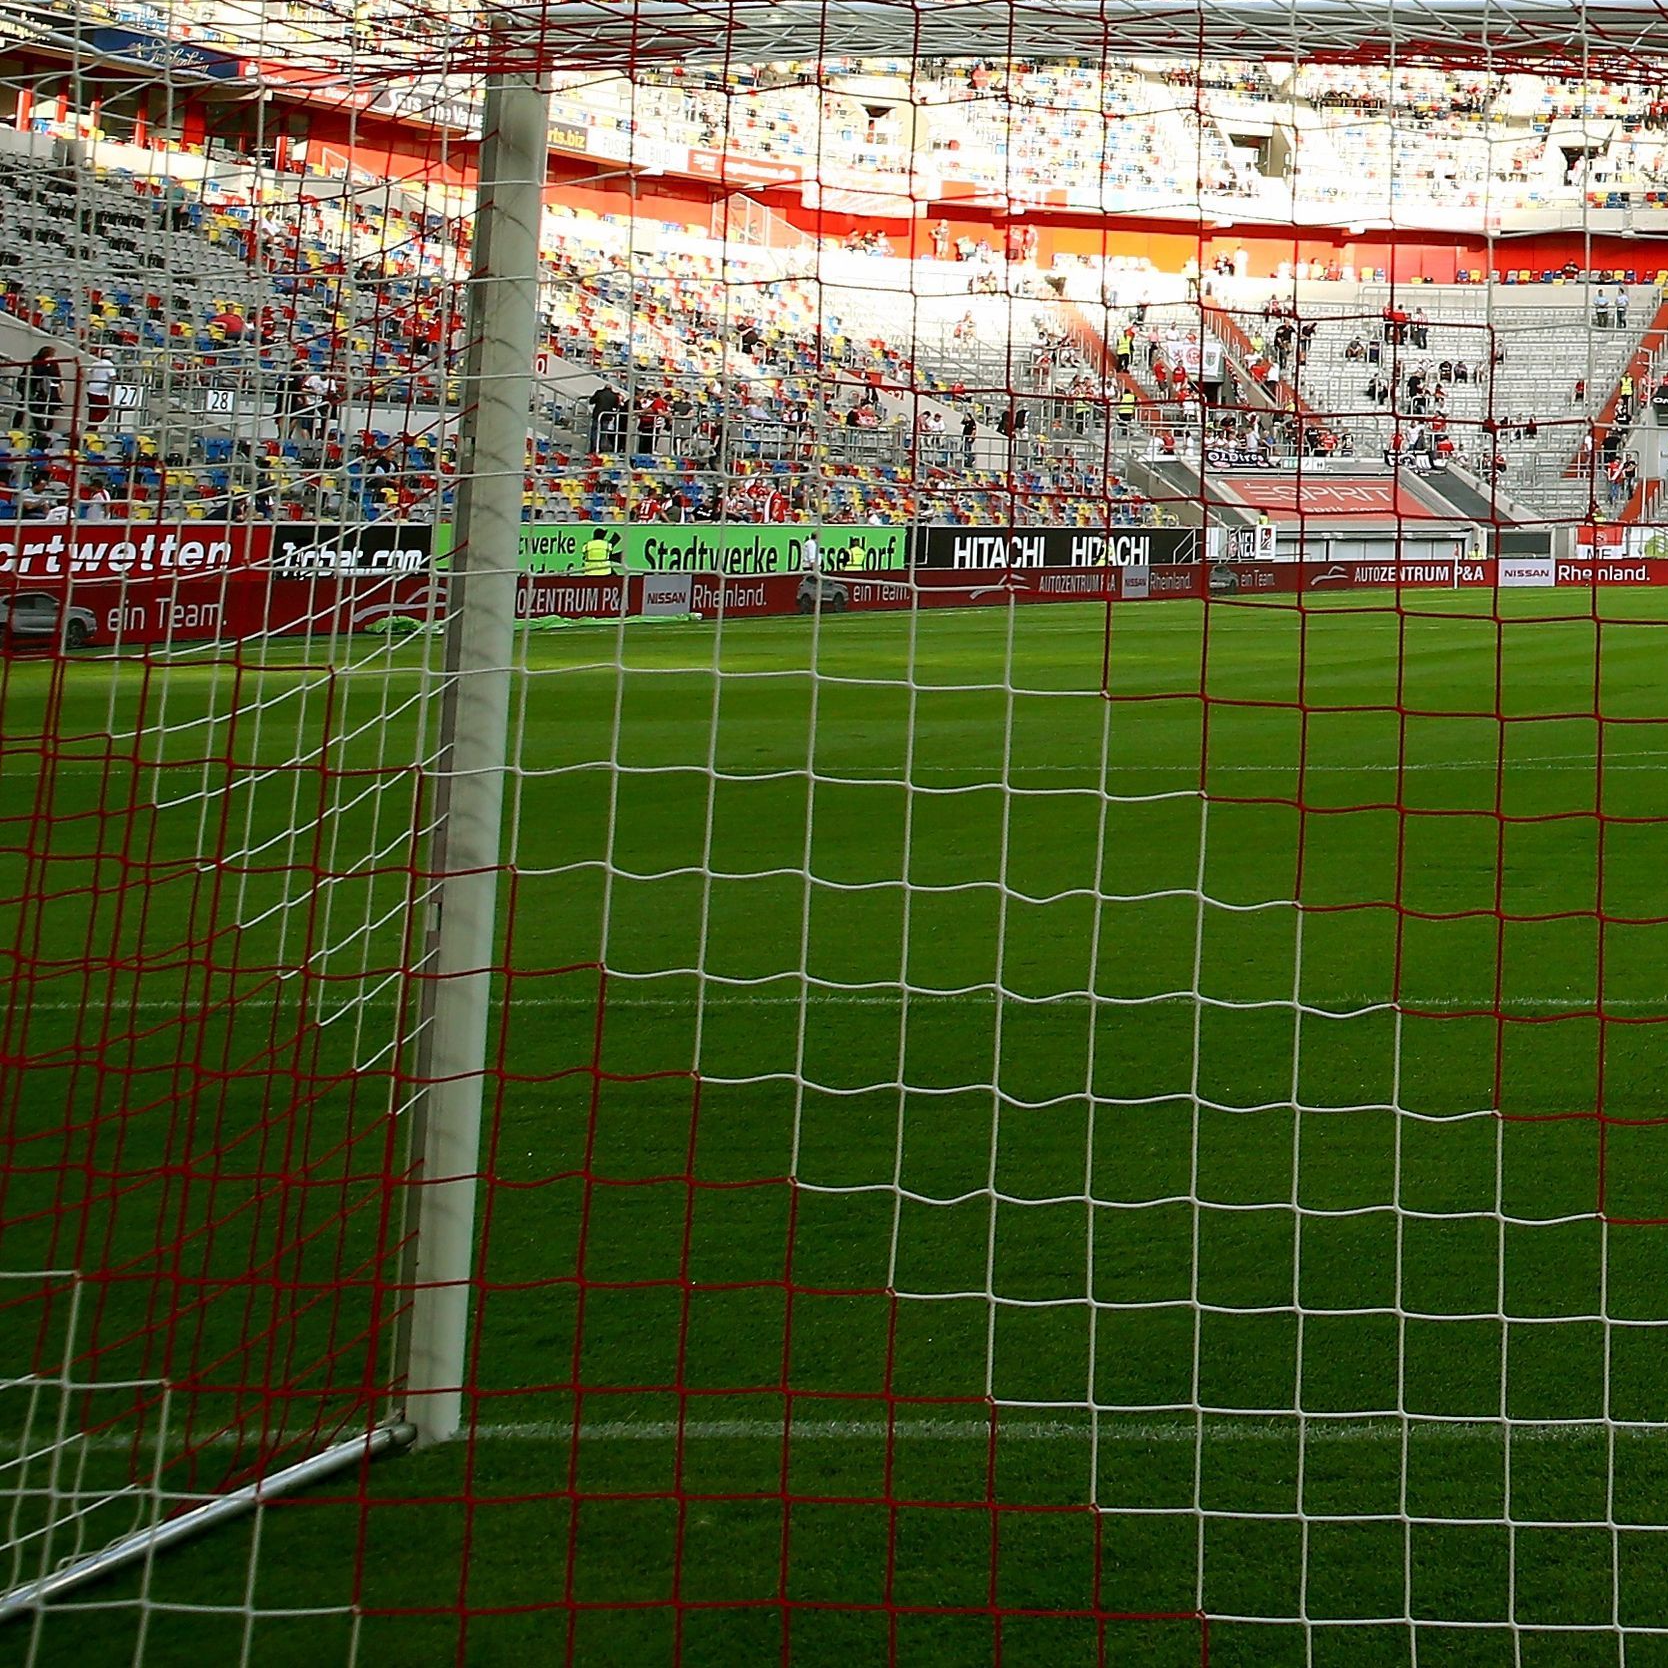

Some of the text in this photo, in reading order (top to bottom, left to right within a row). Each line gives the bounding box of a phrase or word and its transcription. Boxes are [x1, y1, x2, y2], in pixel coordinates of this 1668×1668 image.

[120, 387, 137, 405] 27
[212, 391, 228, 409] 28
[1244, 482, 1390, 502] ESPRIT
[644, 533, 778, 575] Stadtwerke
[787, 535, 897, 572] Dsseorf
[953, 535, 1046, 570] HITACHI
[1150, 572, 1192, 591] Rheinland.
[1354, 565, 1484, 582] AUTOZENTRUM P&A
[1504, 568, 1549, 578] NISSAN
[1559, 564, 1650, 581] Rhenland.
[1039, 574, 1099, 593] AUTOZENTRUM
[602, 586, 630, 612] P&
[648, 592, 687, 604] NISSAN
[692, 582, 768, 609] Rhenland.
[108, 596, 228, 631] ein Team.
